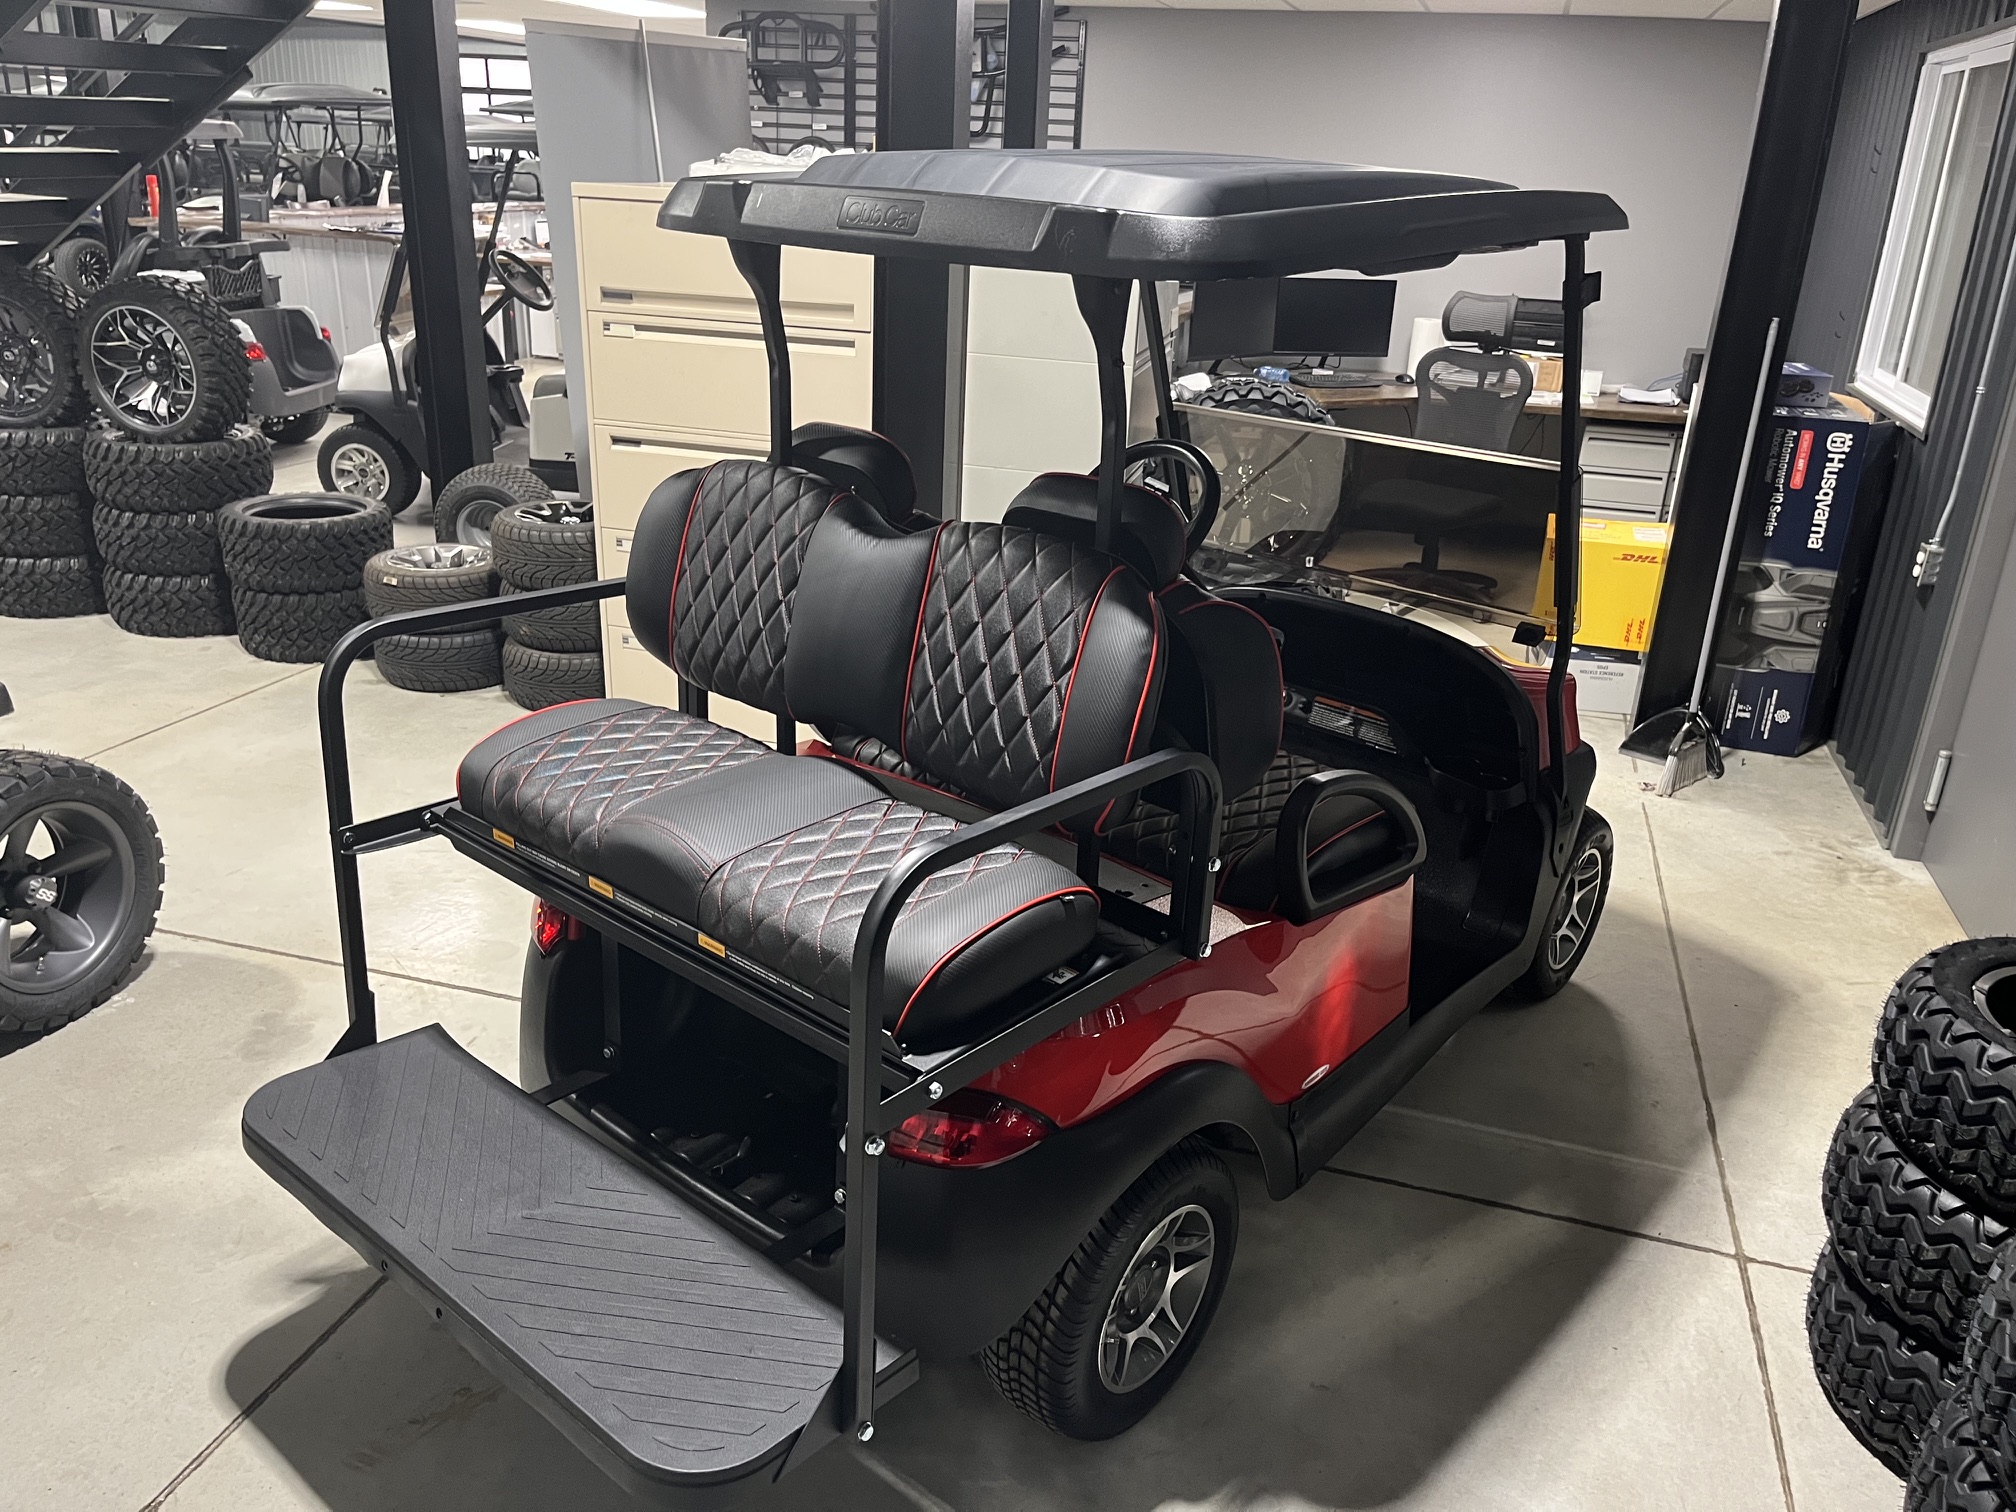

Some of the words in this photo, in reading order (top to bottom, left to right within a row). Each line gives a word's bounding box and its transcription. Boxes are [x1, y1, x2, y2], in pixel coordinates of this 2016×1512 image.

[846, 201, 883, 226] Club
[885, 205, 917, 229] Car
[1770, 492, 1784, 503] IQ
[1807, 453, 1846, 549] Husqvarna
[1764, 505, 1781, 537] Series
[1620, 553, 1658, 564] DHL
[1636, 619, 1645, 640] DHL
[35, 888, 57, 902] SS
